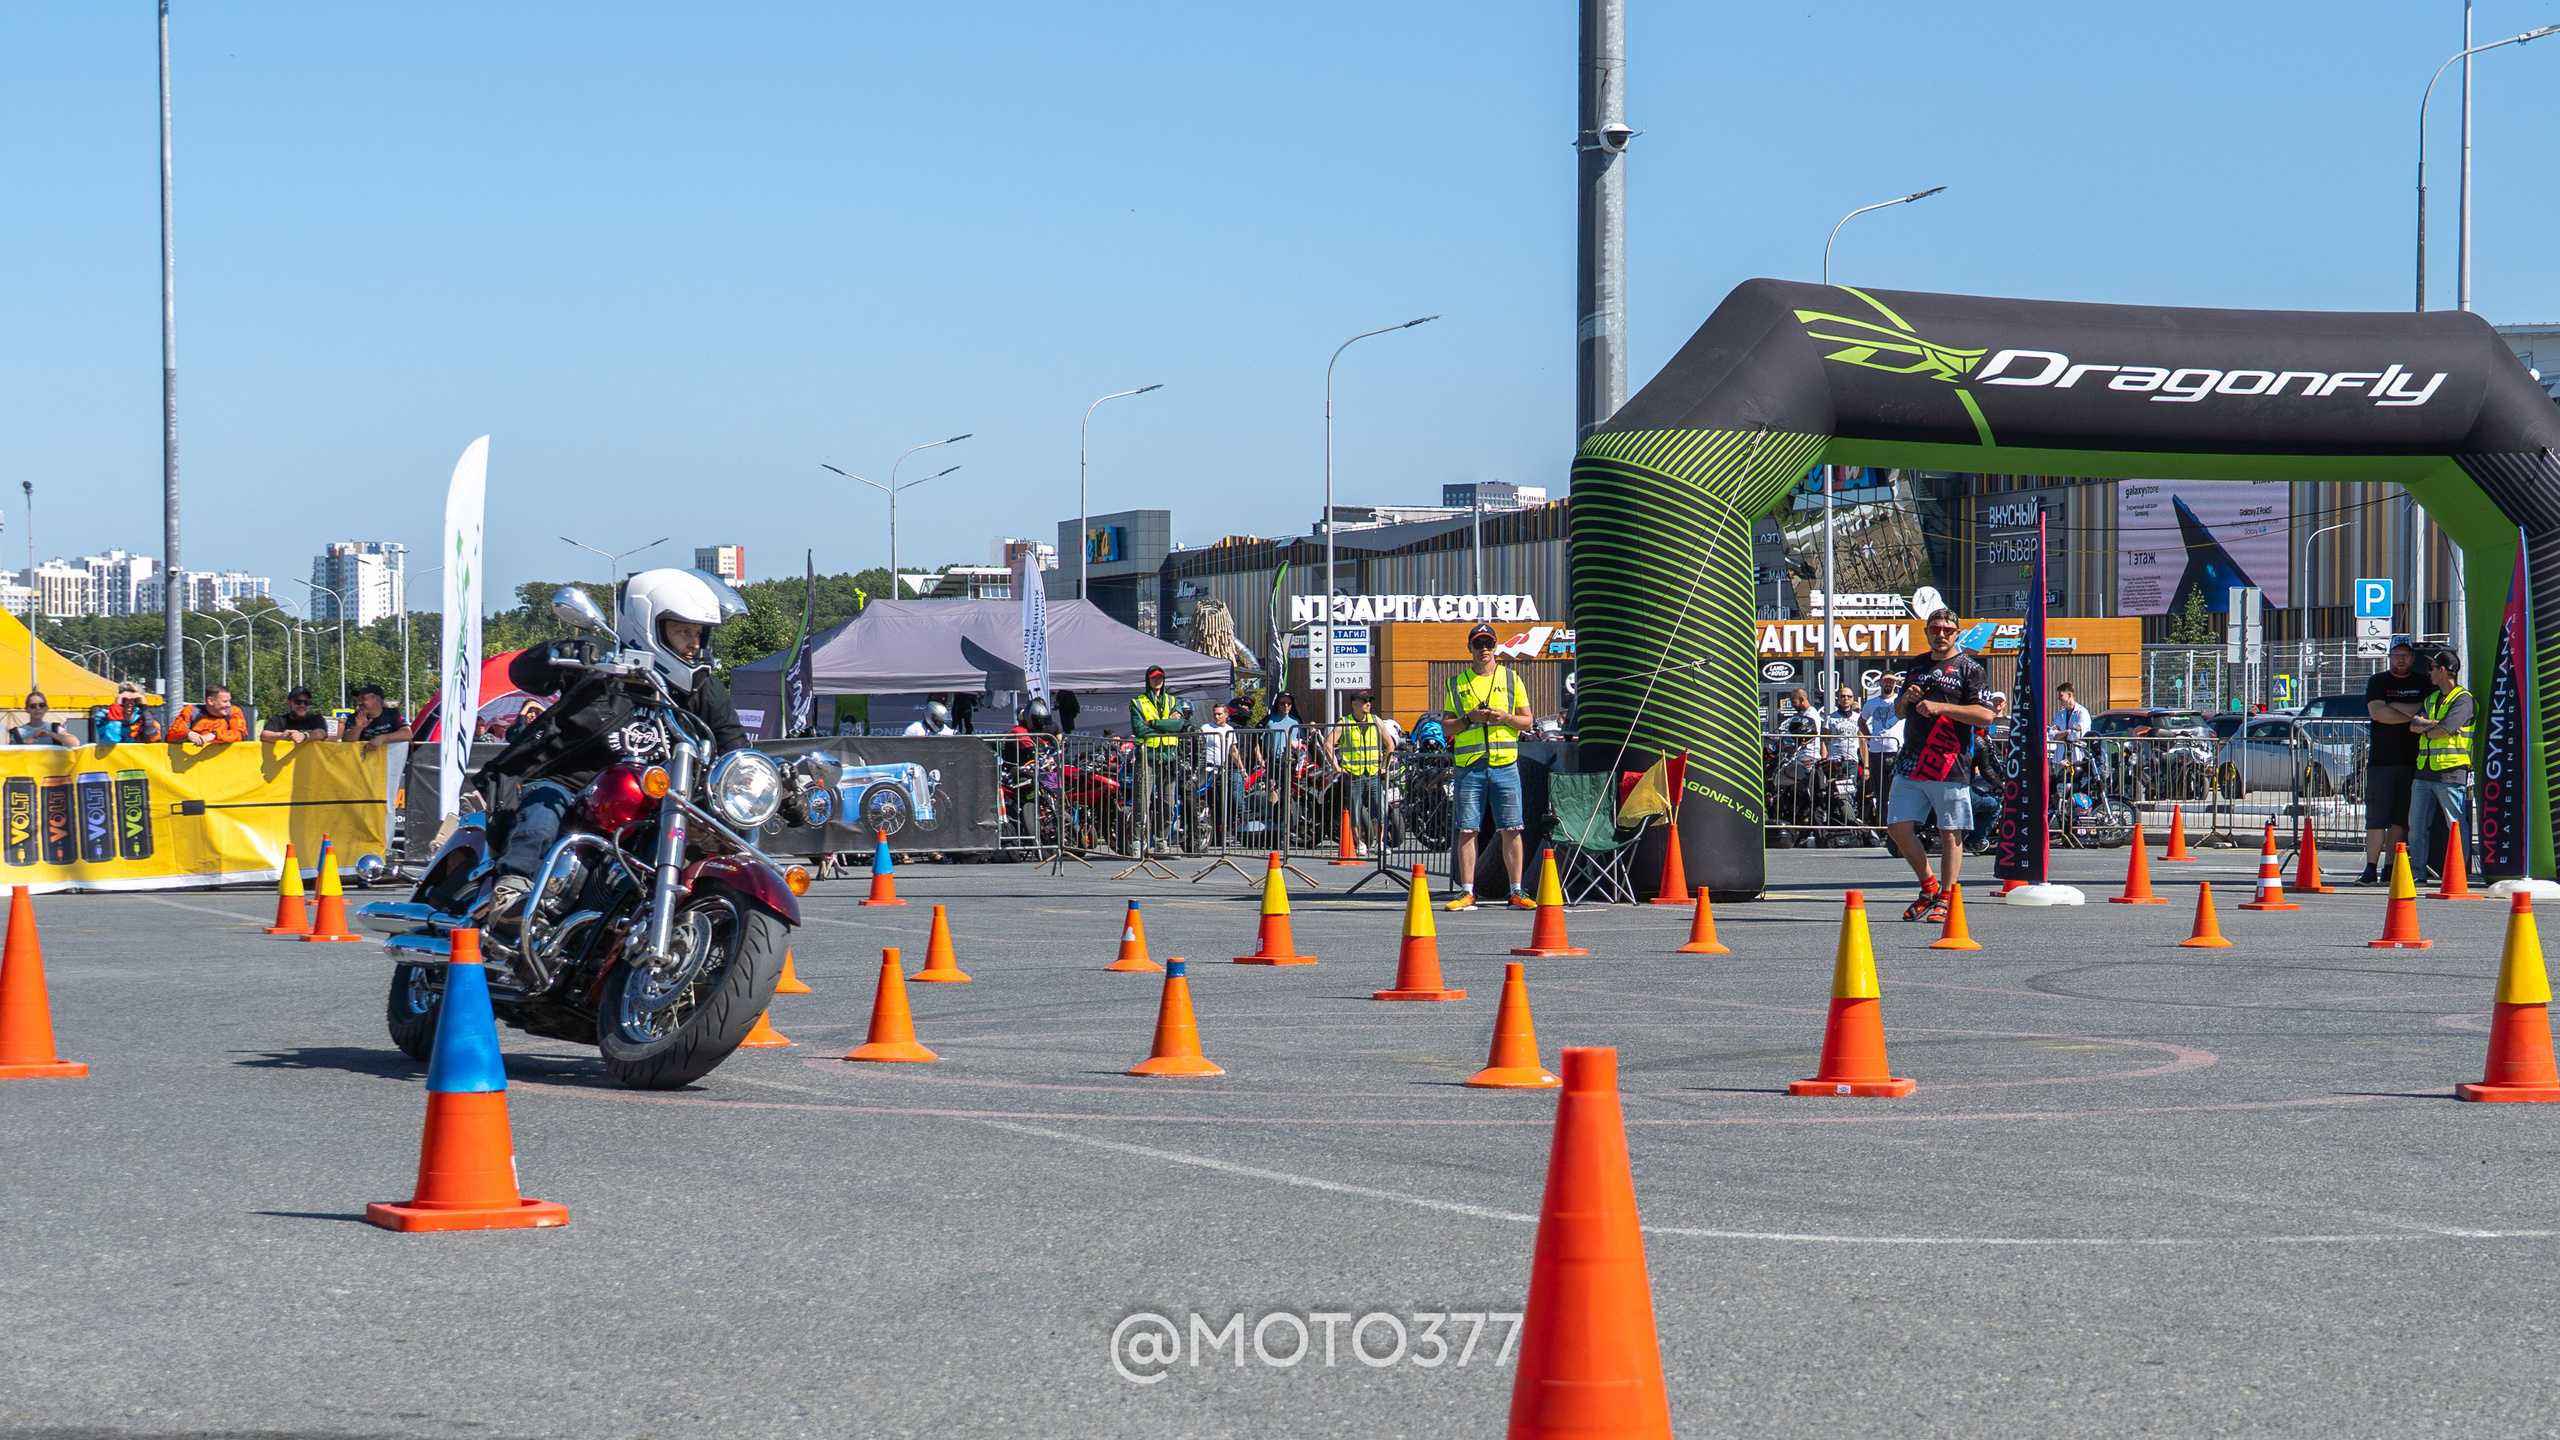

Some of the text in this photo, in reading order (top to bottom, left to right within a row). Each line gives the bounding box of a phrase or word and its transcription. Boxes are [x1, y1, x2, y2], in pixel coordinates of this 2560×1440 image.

[2125, 484, 2159, 499] galaxystore
[2365, 583, 2386, 613] P
[1756, 623, 1910, 653] АПЧАСТИ
[2304, 657, 2314, 666] 13
[1334, 676, 1364, 684] ОКЗАЛ
[1915, 721, 1959, 781] TEAM
[2485, 615, 2513, 863] MOTOGYMKHANA
[2500, 613, 2517, 863] EKATERINBURG TEAM
[2021, 685, 2032, 867] EKATERINBURG
[11, 791, 30, 845] VOLT
[49, 791, 68, 843] VOLT
[86, 787, 107, 841] VOLT
[123, 785, 144, 838] VOLT
